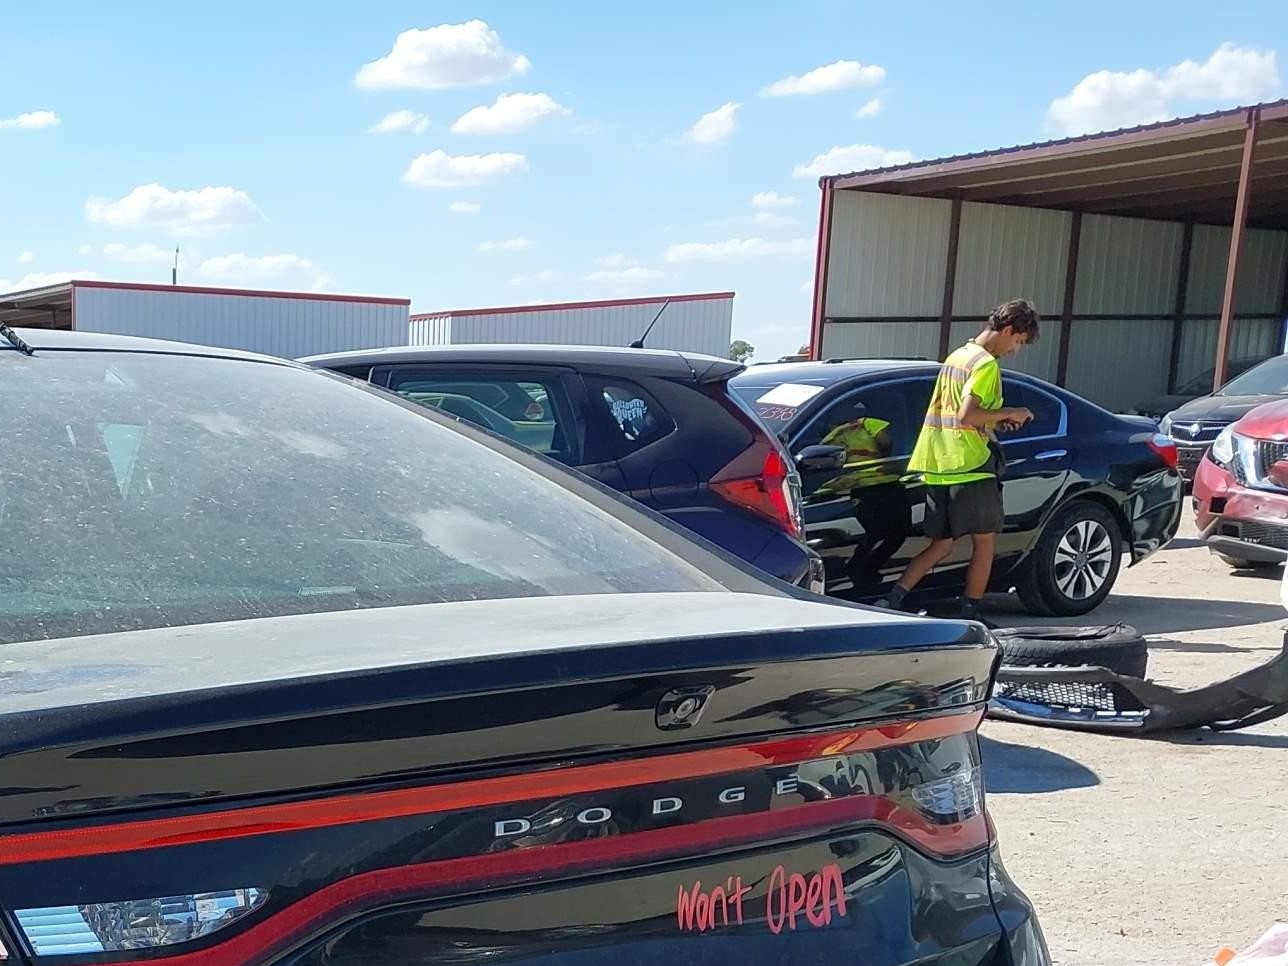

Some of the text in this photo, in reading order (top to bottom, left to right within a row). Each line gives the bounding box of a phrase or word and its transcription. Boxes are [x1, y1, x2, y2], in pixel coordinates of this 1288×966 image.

[495, 777, 800, 837] DODGE
[677, 864, 847, 934] Won't Open
